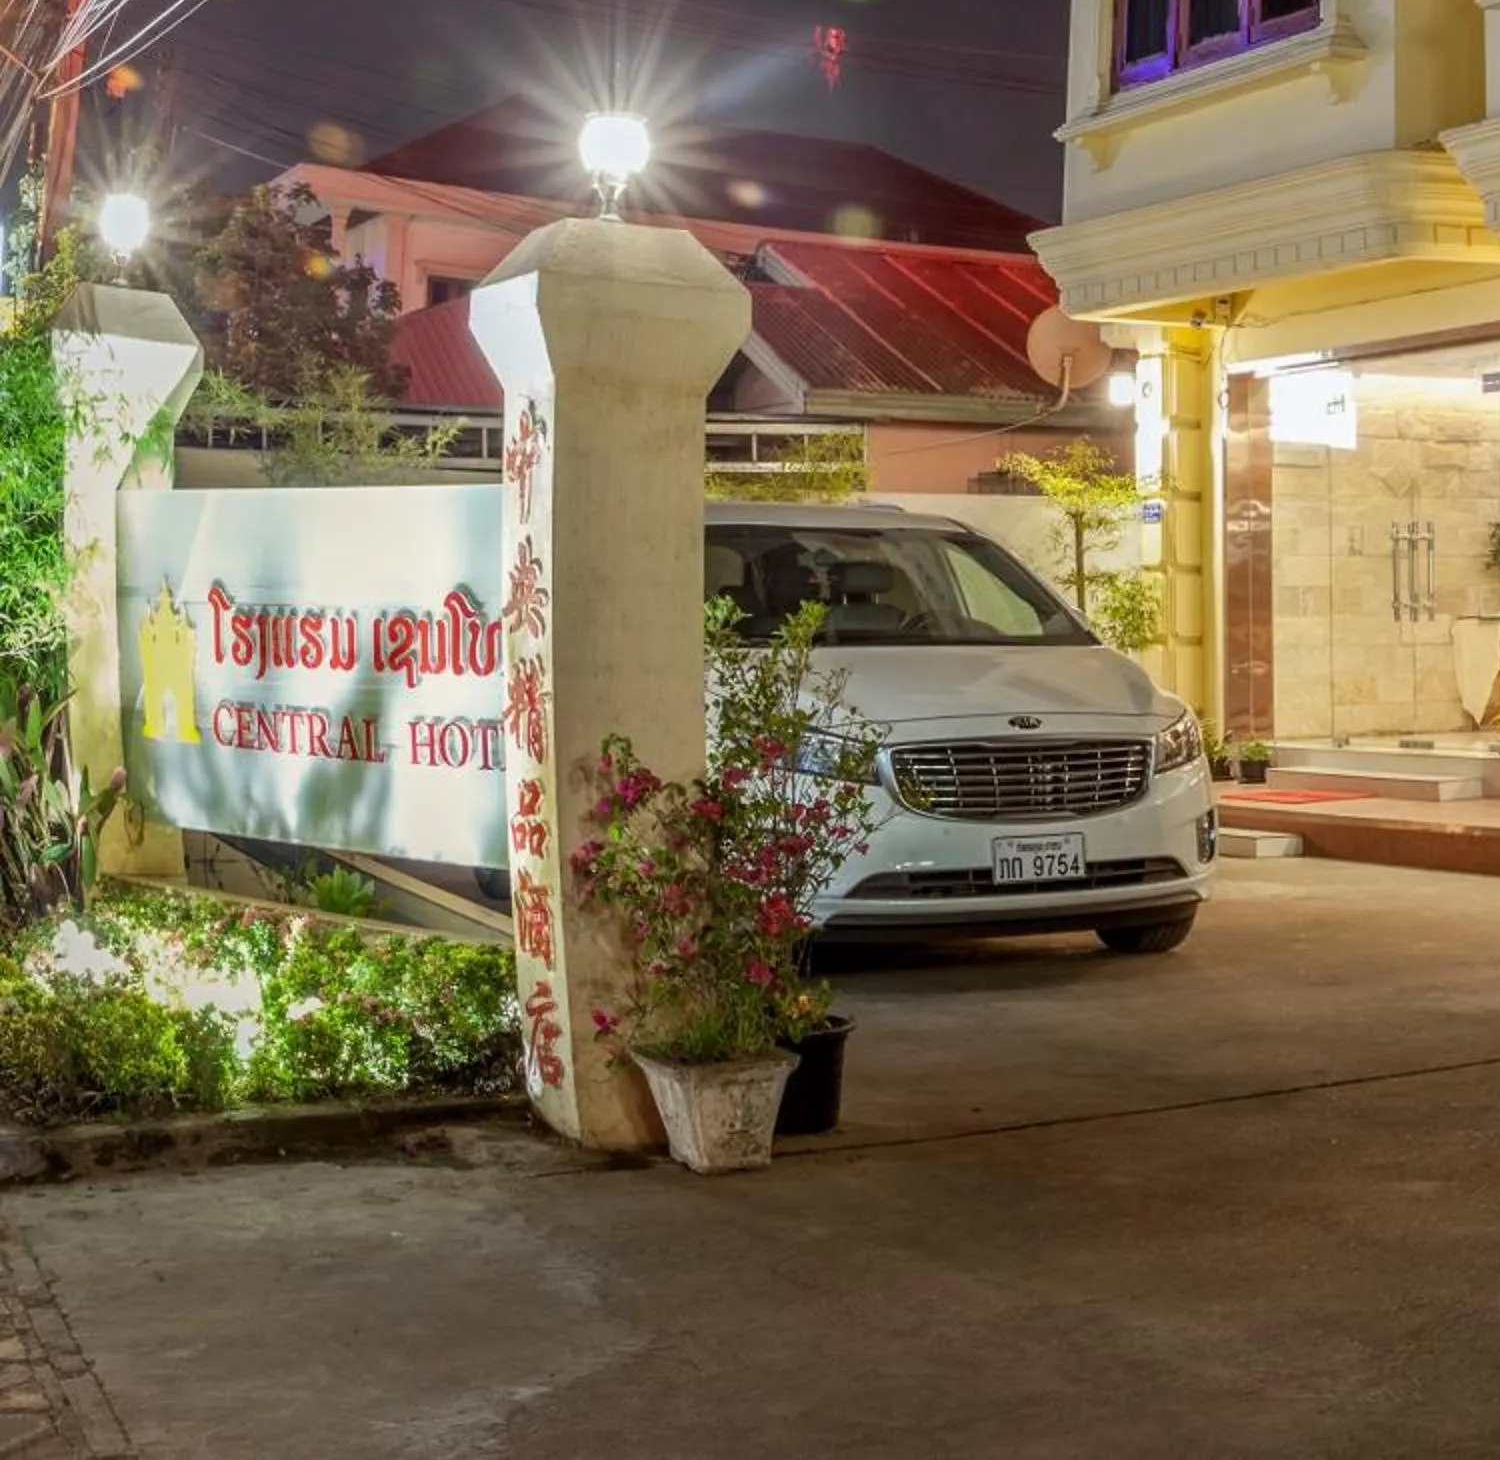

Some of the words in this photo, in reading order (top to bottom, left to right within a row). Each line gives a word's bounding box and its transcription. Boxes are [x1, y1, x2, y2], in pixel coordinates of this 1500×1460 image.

[212, 703, 385, 763] CENTRAL
[408, 720, 506, 771] HOT
[1033, 853, 1081, 878] 9754
